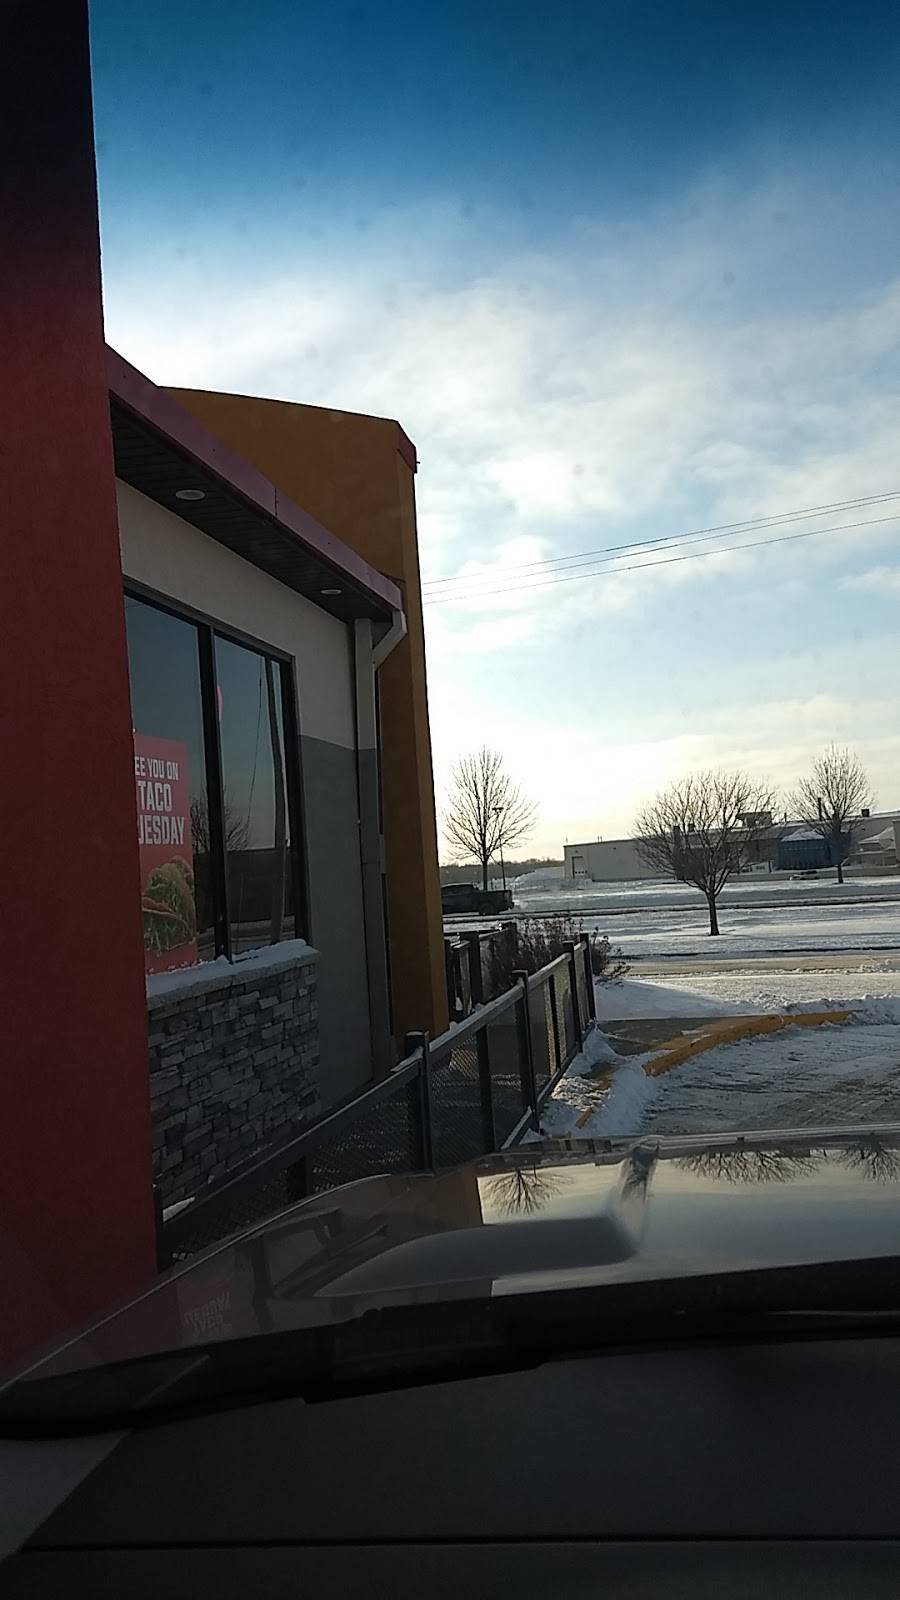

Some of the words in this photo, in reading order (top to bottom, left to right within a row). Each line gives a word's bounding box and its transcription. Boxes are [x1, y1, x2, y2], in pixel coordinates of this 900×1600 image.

[134, 756, 146, 776] EE
[147, 758, 165, 779] YOU
[166, 761, 179, 780] ON
[137, 780, 172, 811] TACO
